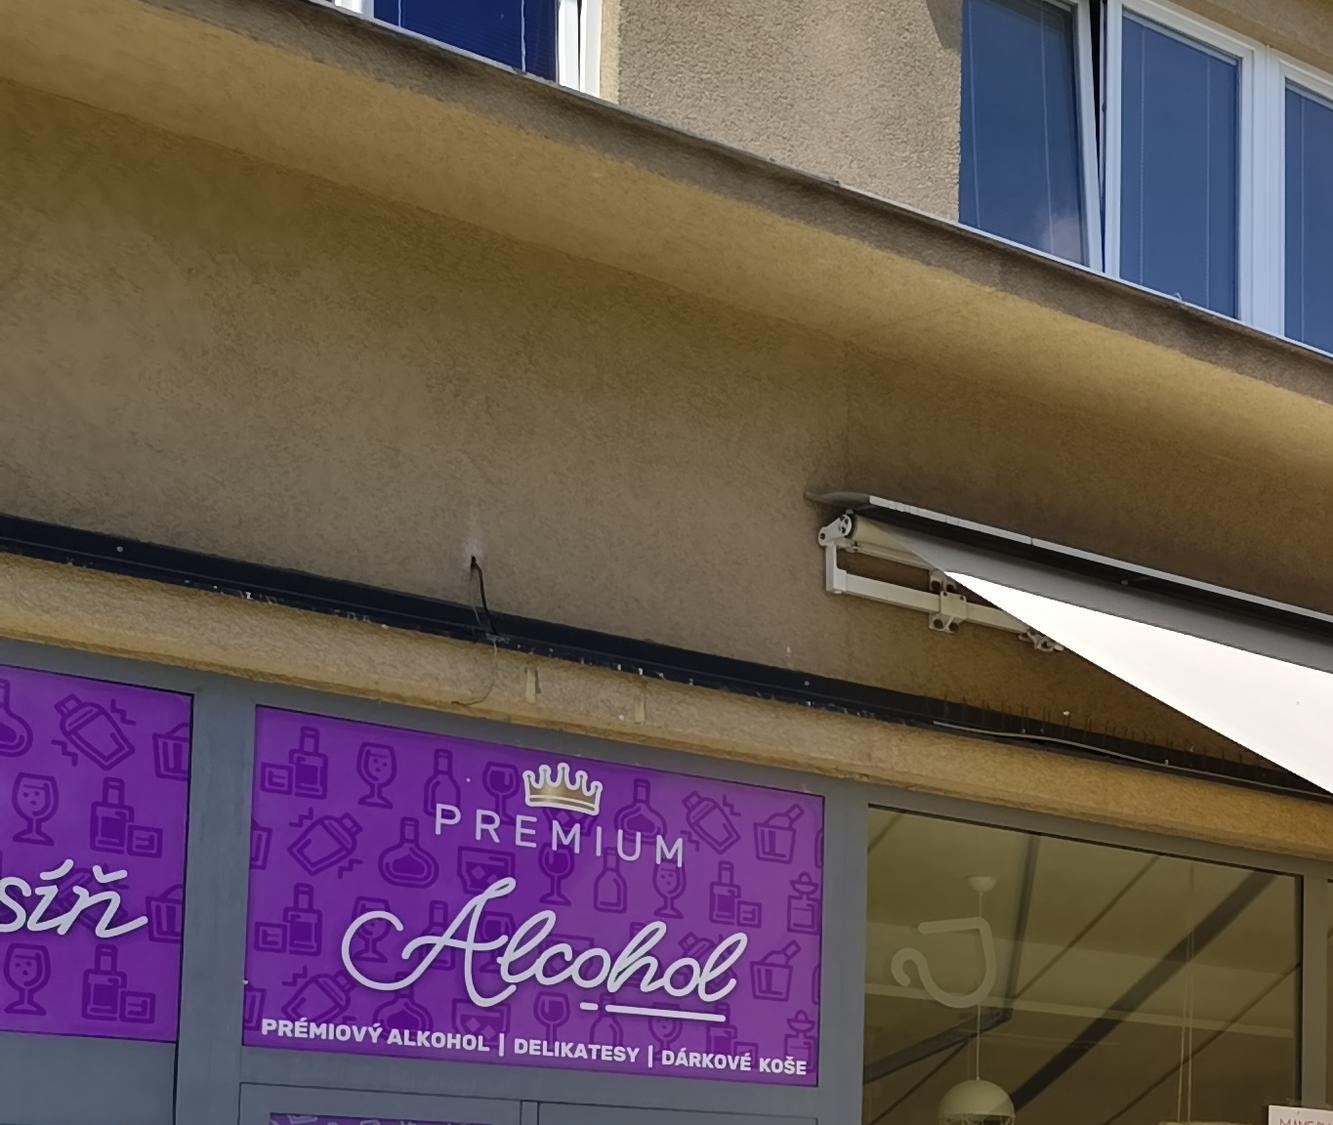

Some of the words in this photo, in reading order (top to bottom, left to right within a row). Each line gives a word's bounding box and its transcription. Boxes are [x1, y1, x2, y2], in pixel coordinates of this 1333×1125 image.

[434, 802, 685, 868] PREMIUM
[341, 877, 747, 1008] Alcohol
[261, 1018, 383, 1045] PRÉMIOVÝ
[387, 1027, 490, 1052] ALKOHOL
[514, 1037, 640, 1063] DELIKATESY
[661, 1046, 752, 1072] DÁRKOVÉ
[758, 1053, 807, 1076] KOŠE
